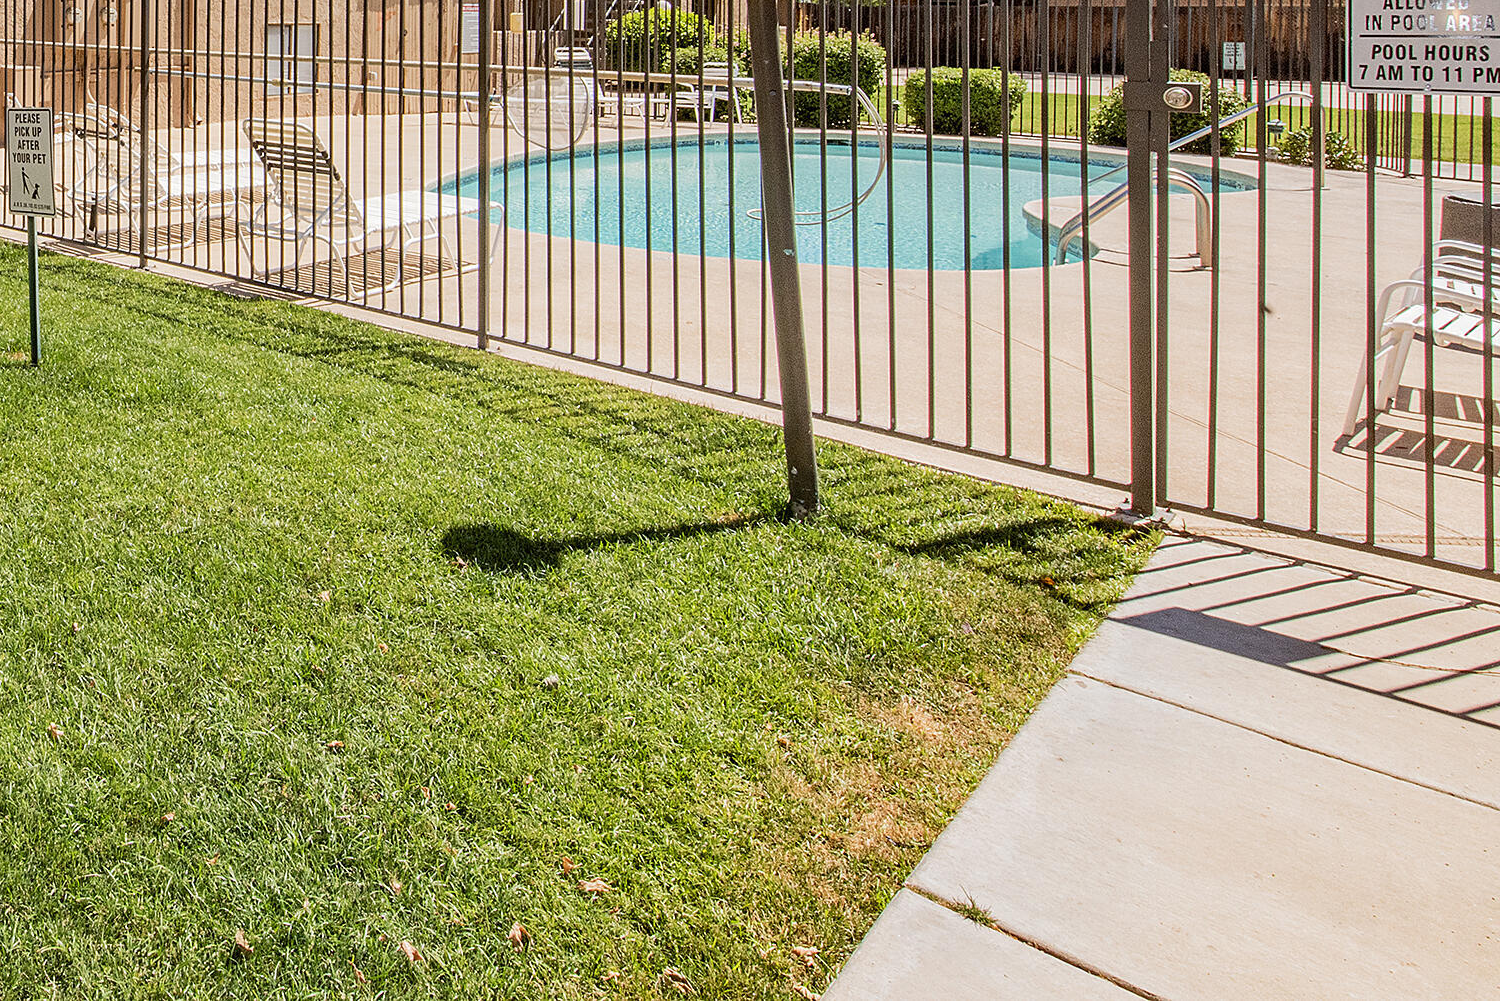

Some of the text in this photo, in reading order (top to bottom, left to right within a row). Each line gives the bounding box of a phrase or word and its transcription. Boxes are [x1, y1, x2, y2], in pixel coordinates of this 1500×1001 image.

[1365, 14, 1495, 32] IN POOL AREA
[1371, 44, 1490, 62] POOL HOURS
[1359, 65, 1500, 83] 7 AM TO 11 PM
[15, 113, 41, 124] PLEASE
[14, 126, 42, 137] PICK UP
[17, 139, 40, 151] AFTER
[12, 152, 46, 165] YOUR PET
